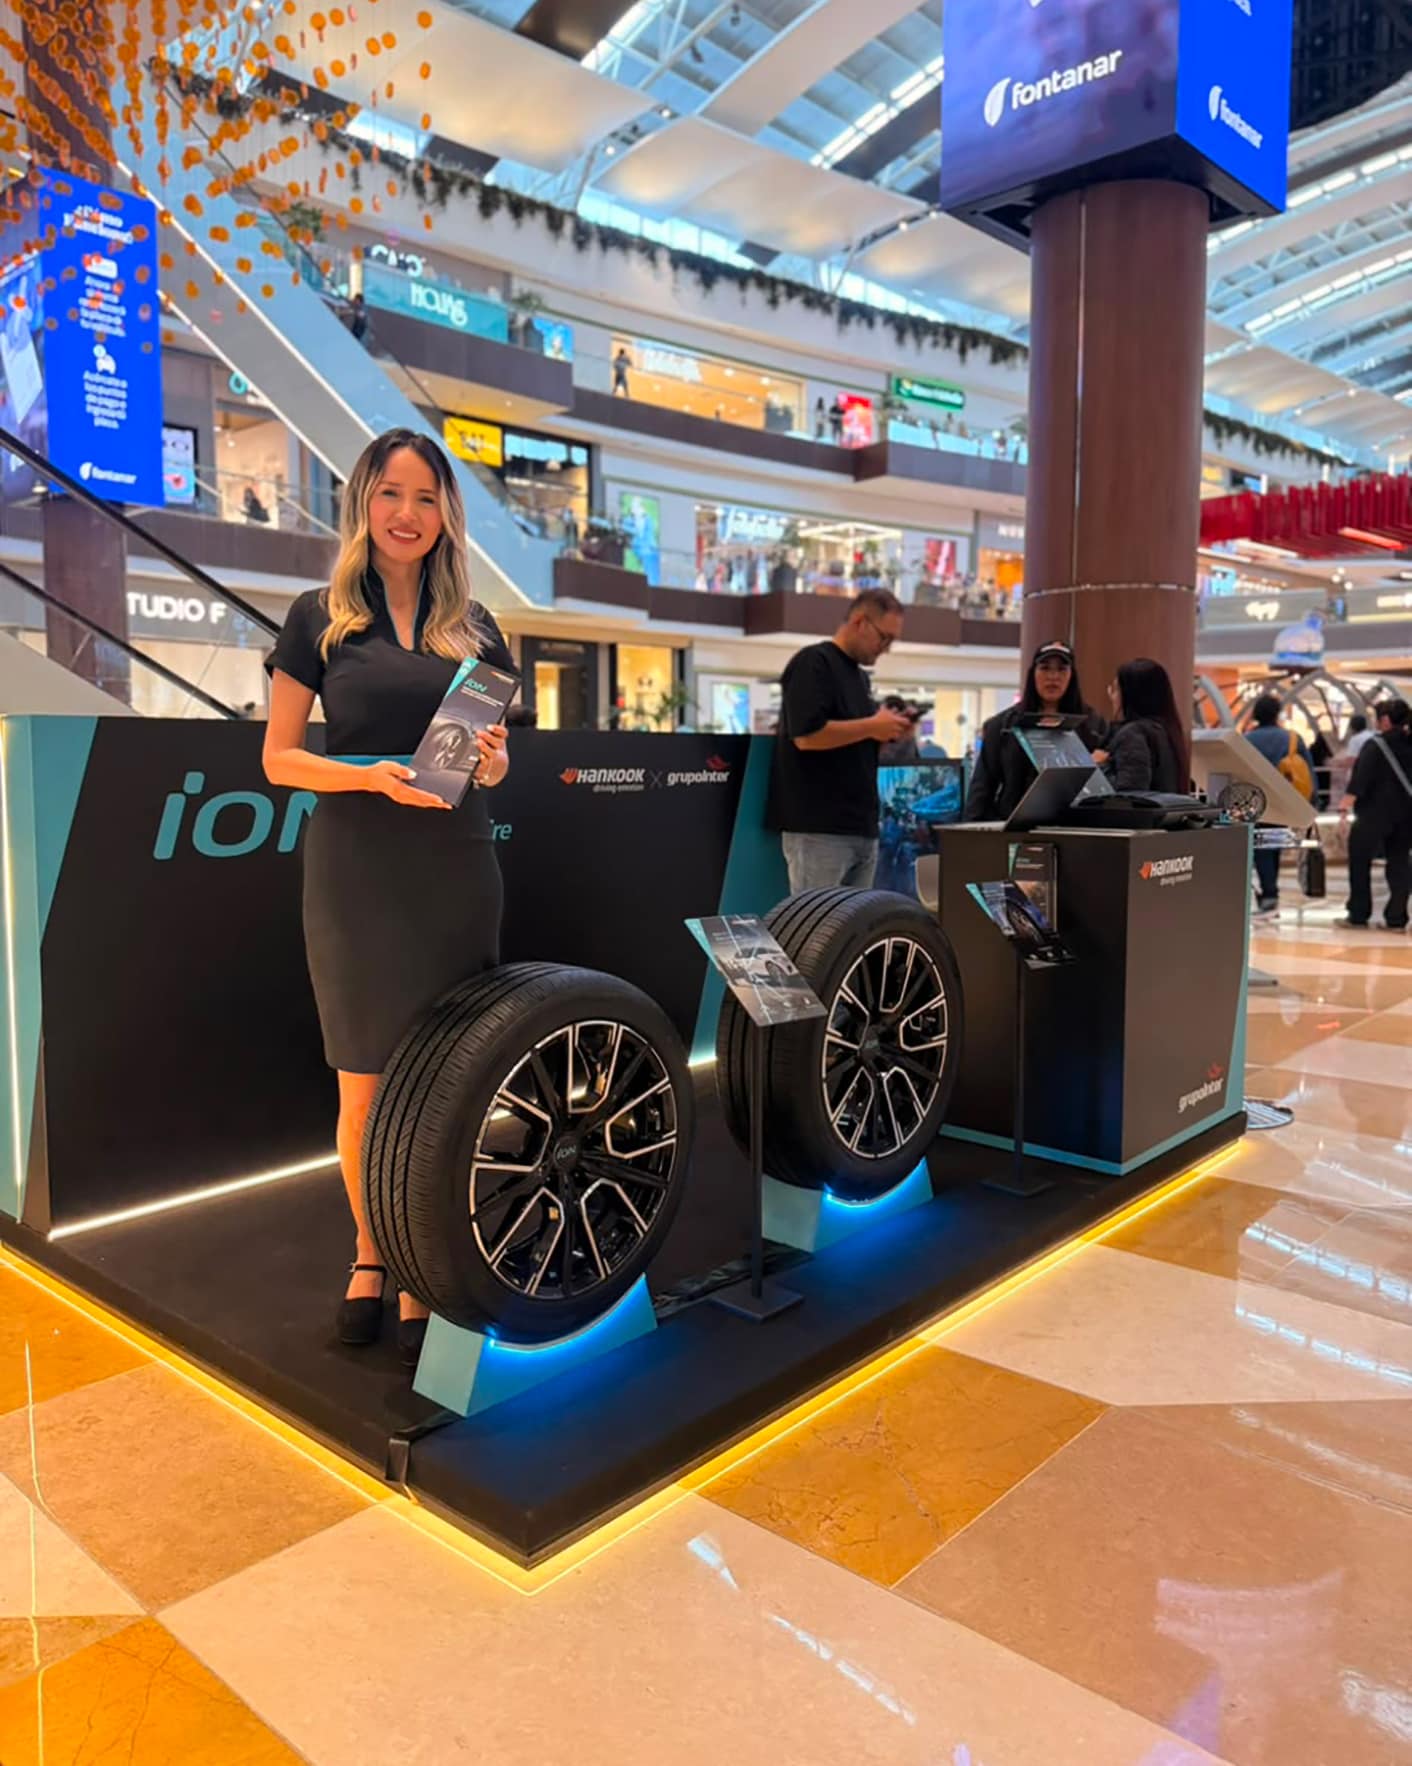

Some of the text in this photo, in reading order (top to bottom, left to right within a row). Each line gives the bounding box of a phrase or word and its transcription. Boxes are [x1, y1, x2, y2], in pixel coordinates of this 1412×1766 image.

[1012, 50, 1122, 110] fontanar
[1220, 98, 1263, 149] fontanar
[126, 592, 227, 624] TUDIO F
